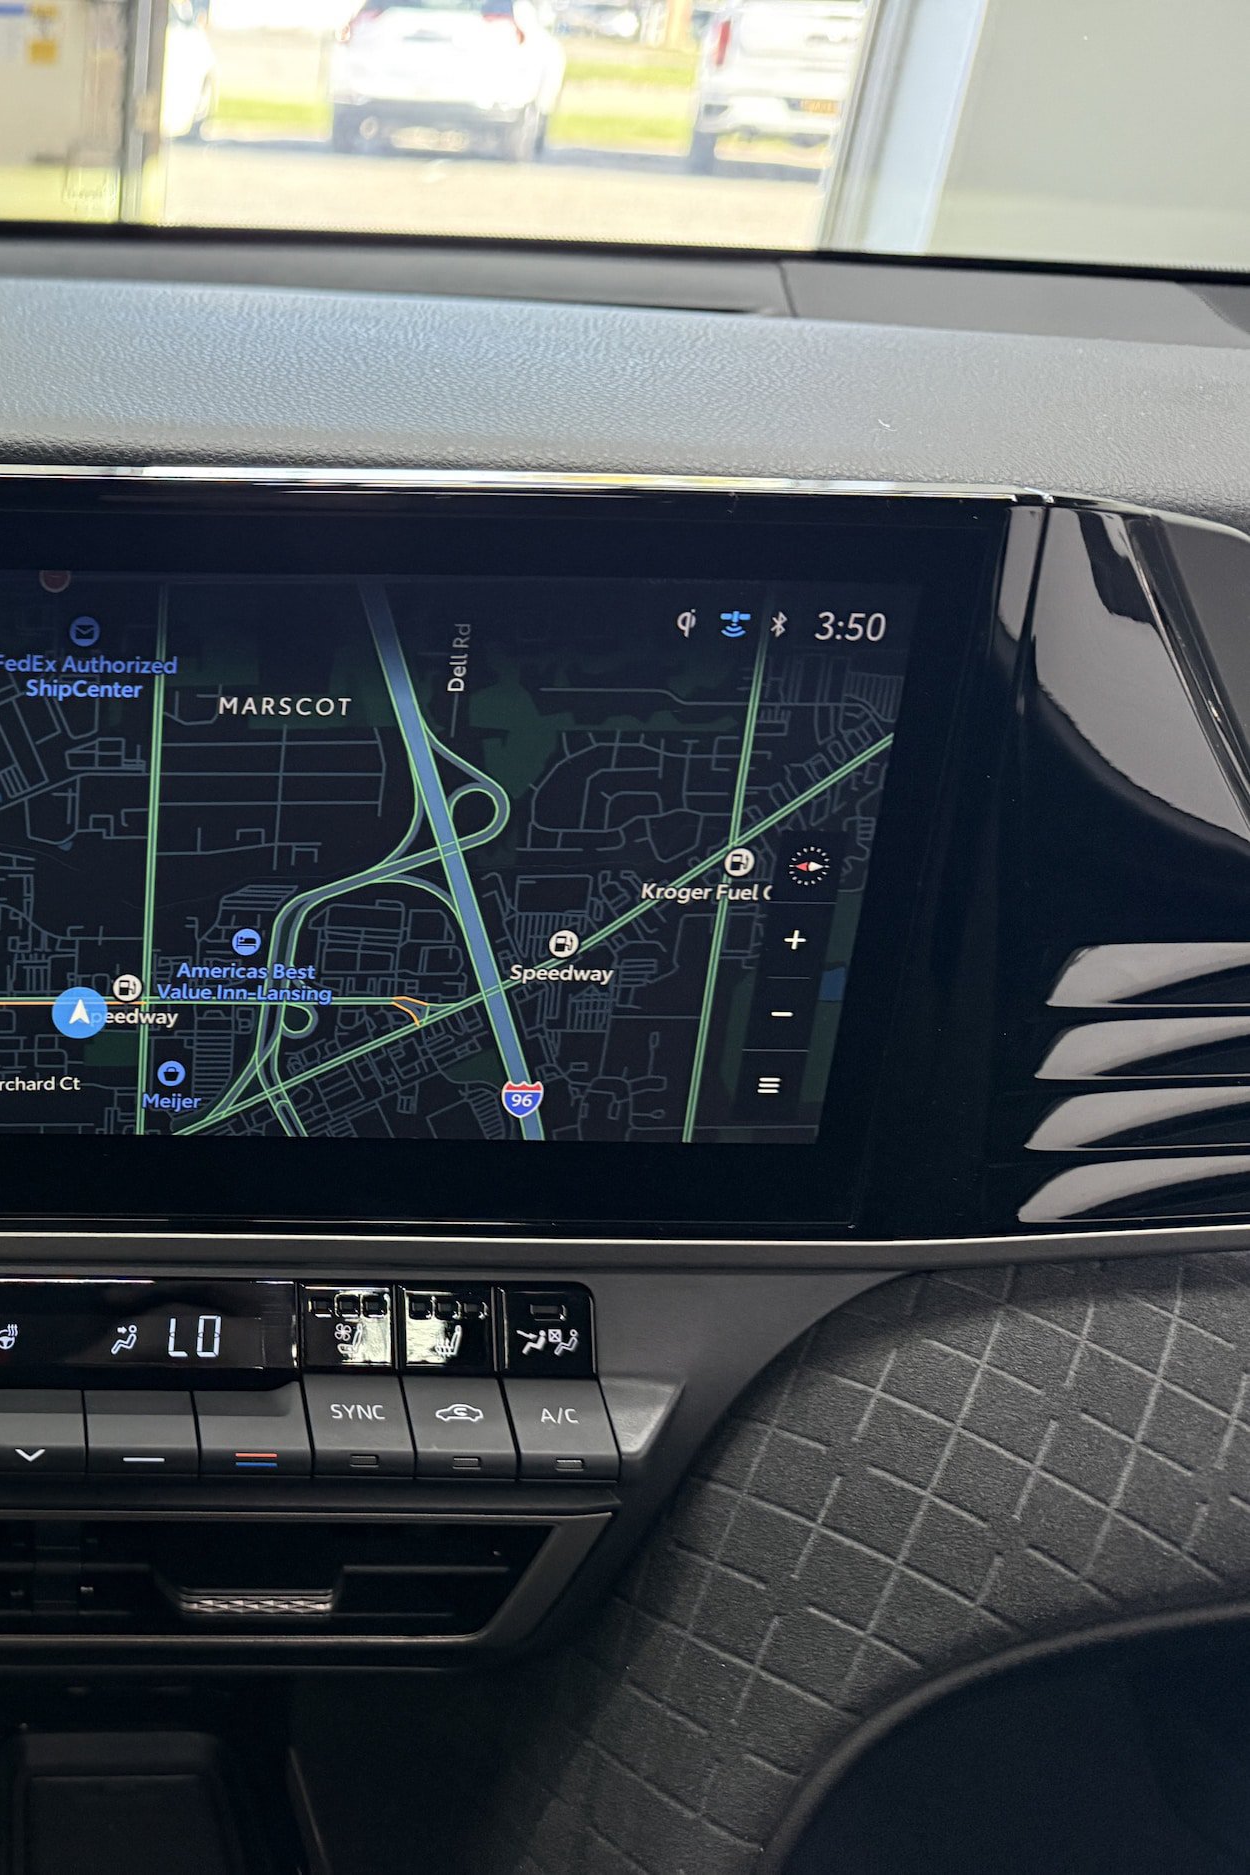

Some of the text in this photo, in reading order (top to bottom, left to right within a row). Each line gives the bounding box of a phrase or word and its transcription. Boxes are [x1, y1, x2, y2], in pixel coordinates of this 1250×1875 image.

[814, 611, 887, 643] 3:50
[63, 655, 178, 674] Authorized
[447, 623, 471, 692] Dell Rd
[25, 678, 143, 700] ShipCenter
[218, 696, 352, 717] MARSCOT
[641, 883, 713, 904] Kroger
[716, 884, 759, 901] Fuel
[177, 963, 316, 981] Americas Best
[510, 964, 614, 985] Speedway
[157, 982, 333, 1006] Value Inn-Lansing
[90, 1007, 179, 1028] peedway
[59, 1077, 81, 1092] Ct
[142, 1093, 201, 1112] Meijer
[511, 1093, 534, 1108] 96
[330, 1404, 386, 1422] SYNC
[540, 1408, 580, 1425] A/C
